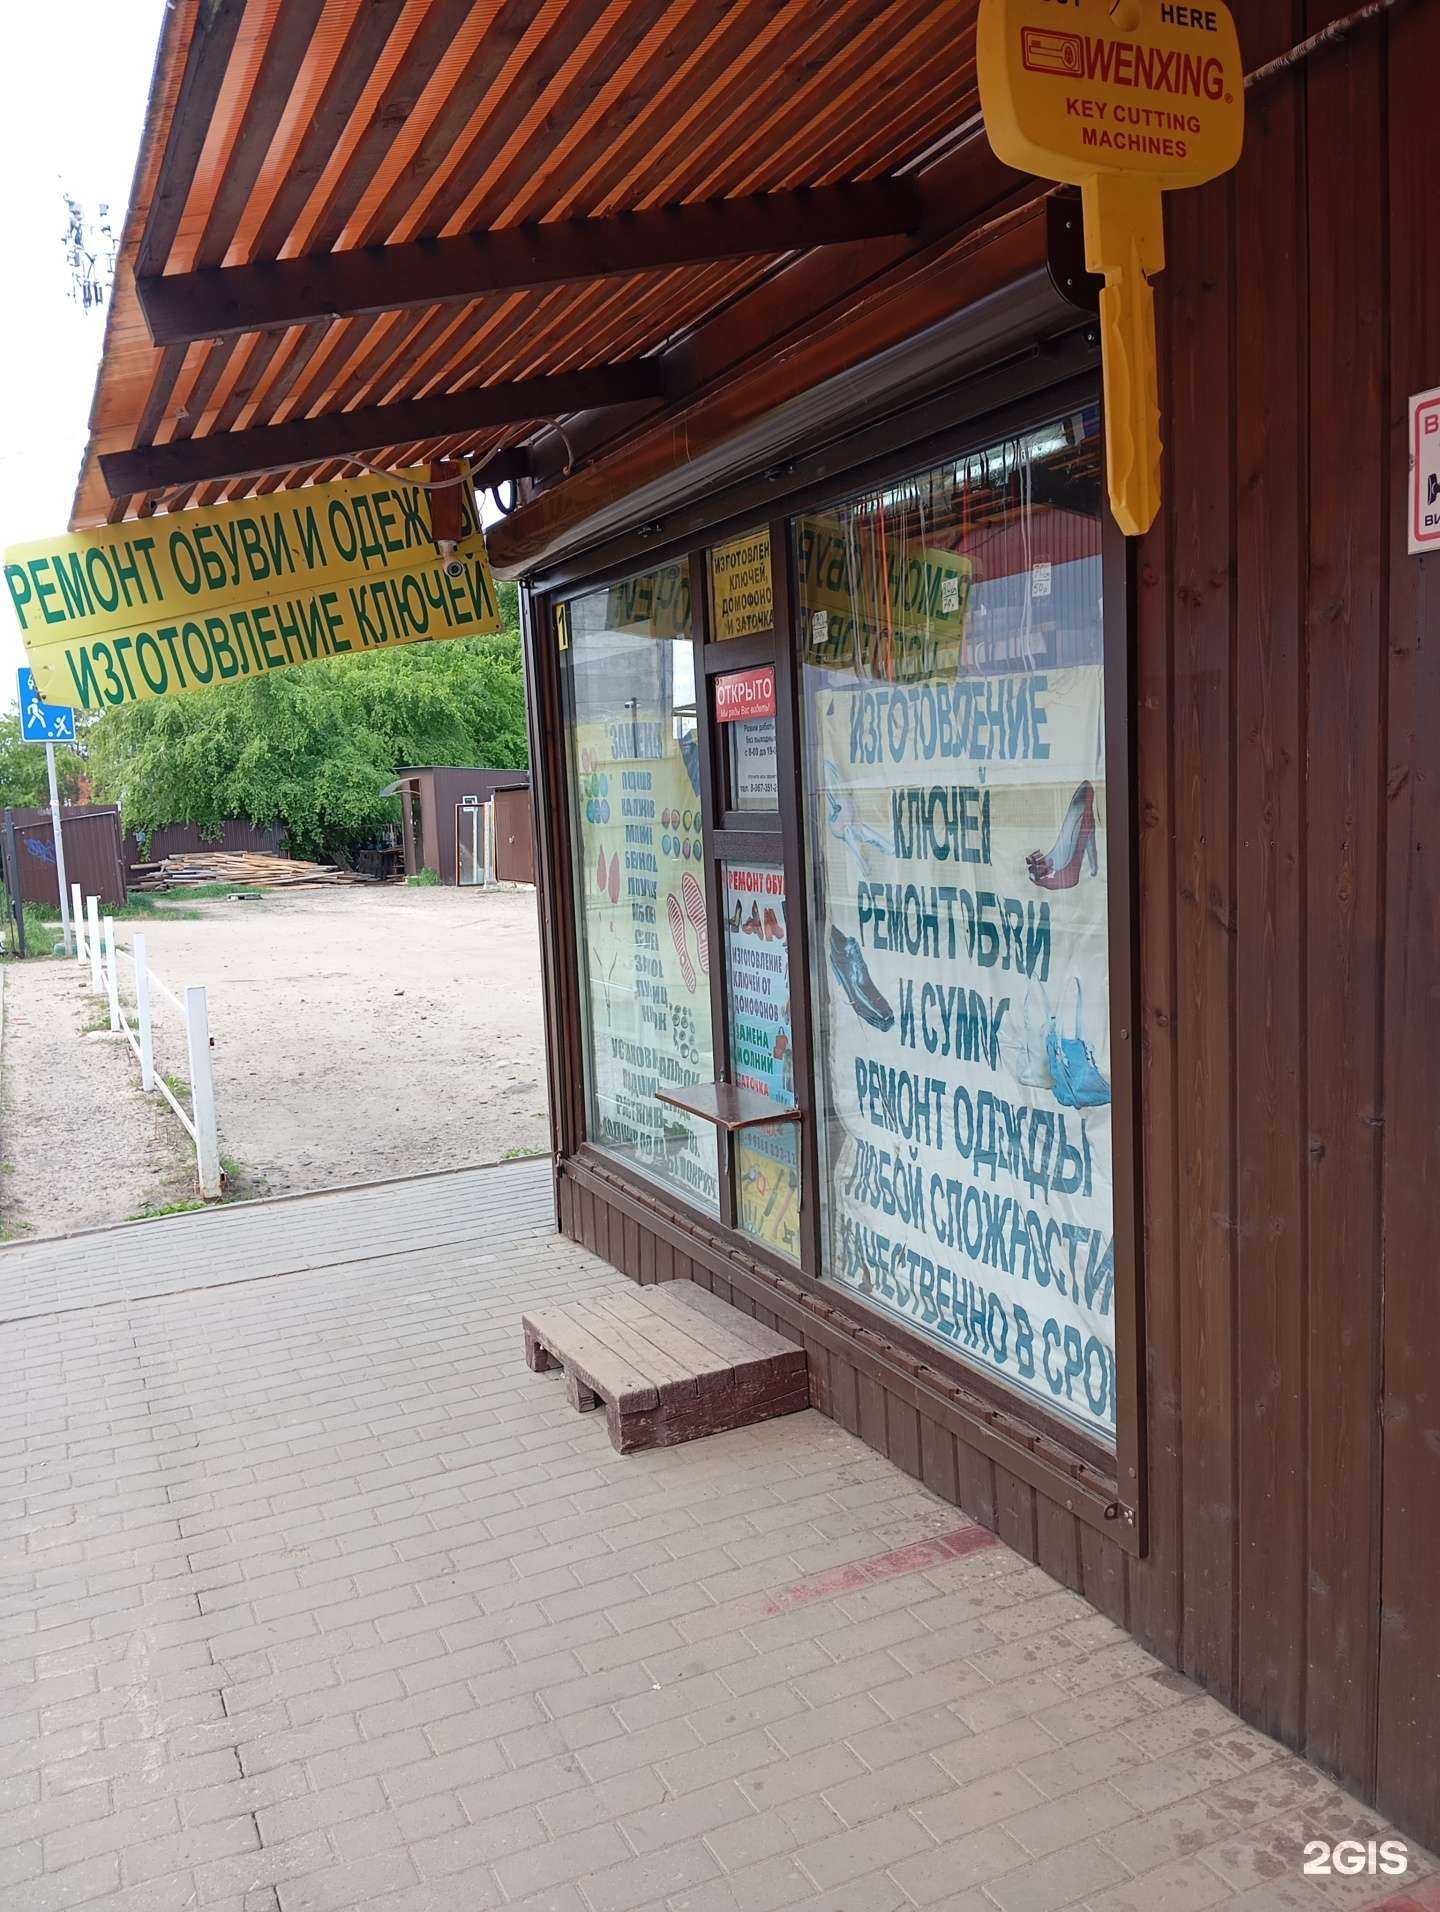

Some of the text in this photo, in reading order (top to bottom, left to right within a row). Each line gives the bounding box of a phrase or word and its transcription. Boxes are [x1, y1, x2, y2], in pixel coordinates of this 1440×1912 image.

[1160, 3, 1218, 32] HERE
[1066, 97, 1201, 134] KEY CUTTING
[1082, 127, 1188, 158] MACHINES
[4, 480, 481, 630] РЕМОНТ ОБУВИ И ОДЕЖЫ
[65, 591, 352, 709] ИЗГОТОВЛЕНИЕ
[349, 552, 494, 646] КЛЮЧЕЙ
[717, 678, 772, 705] ОТКРЫТО
[850, 675, 1051, 764] ИЗГОТОВЛЕНИЕ
[729, 871, 763, 893] РЕМОНТ
[857, 880, 959, 959] РЕМОНТ
[732, 946, 783, 973] ИЗГОТОВЛЕНИЕ
[762, 977, 771, 995] ОТ
[900, 977, 916, 1049] И
[855, 1056, 947, 1151] РЕМОНТ
[845, 1138, 1116, 1316] ЛЮБОЙ СЛОЖНОСТИ
[1012, 1303, 1036, 1379] В
